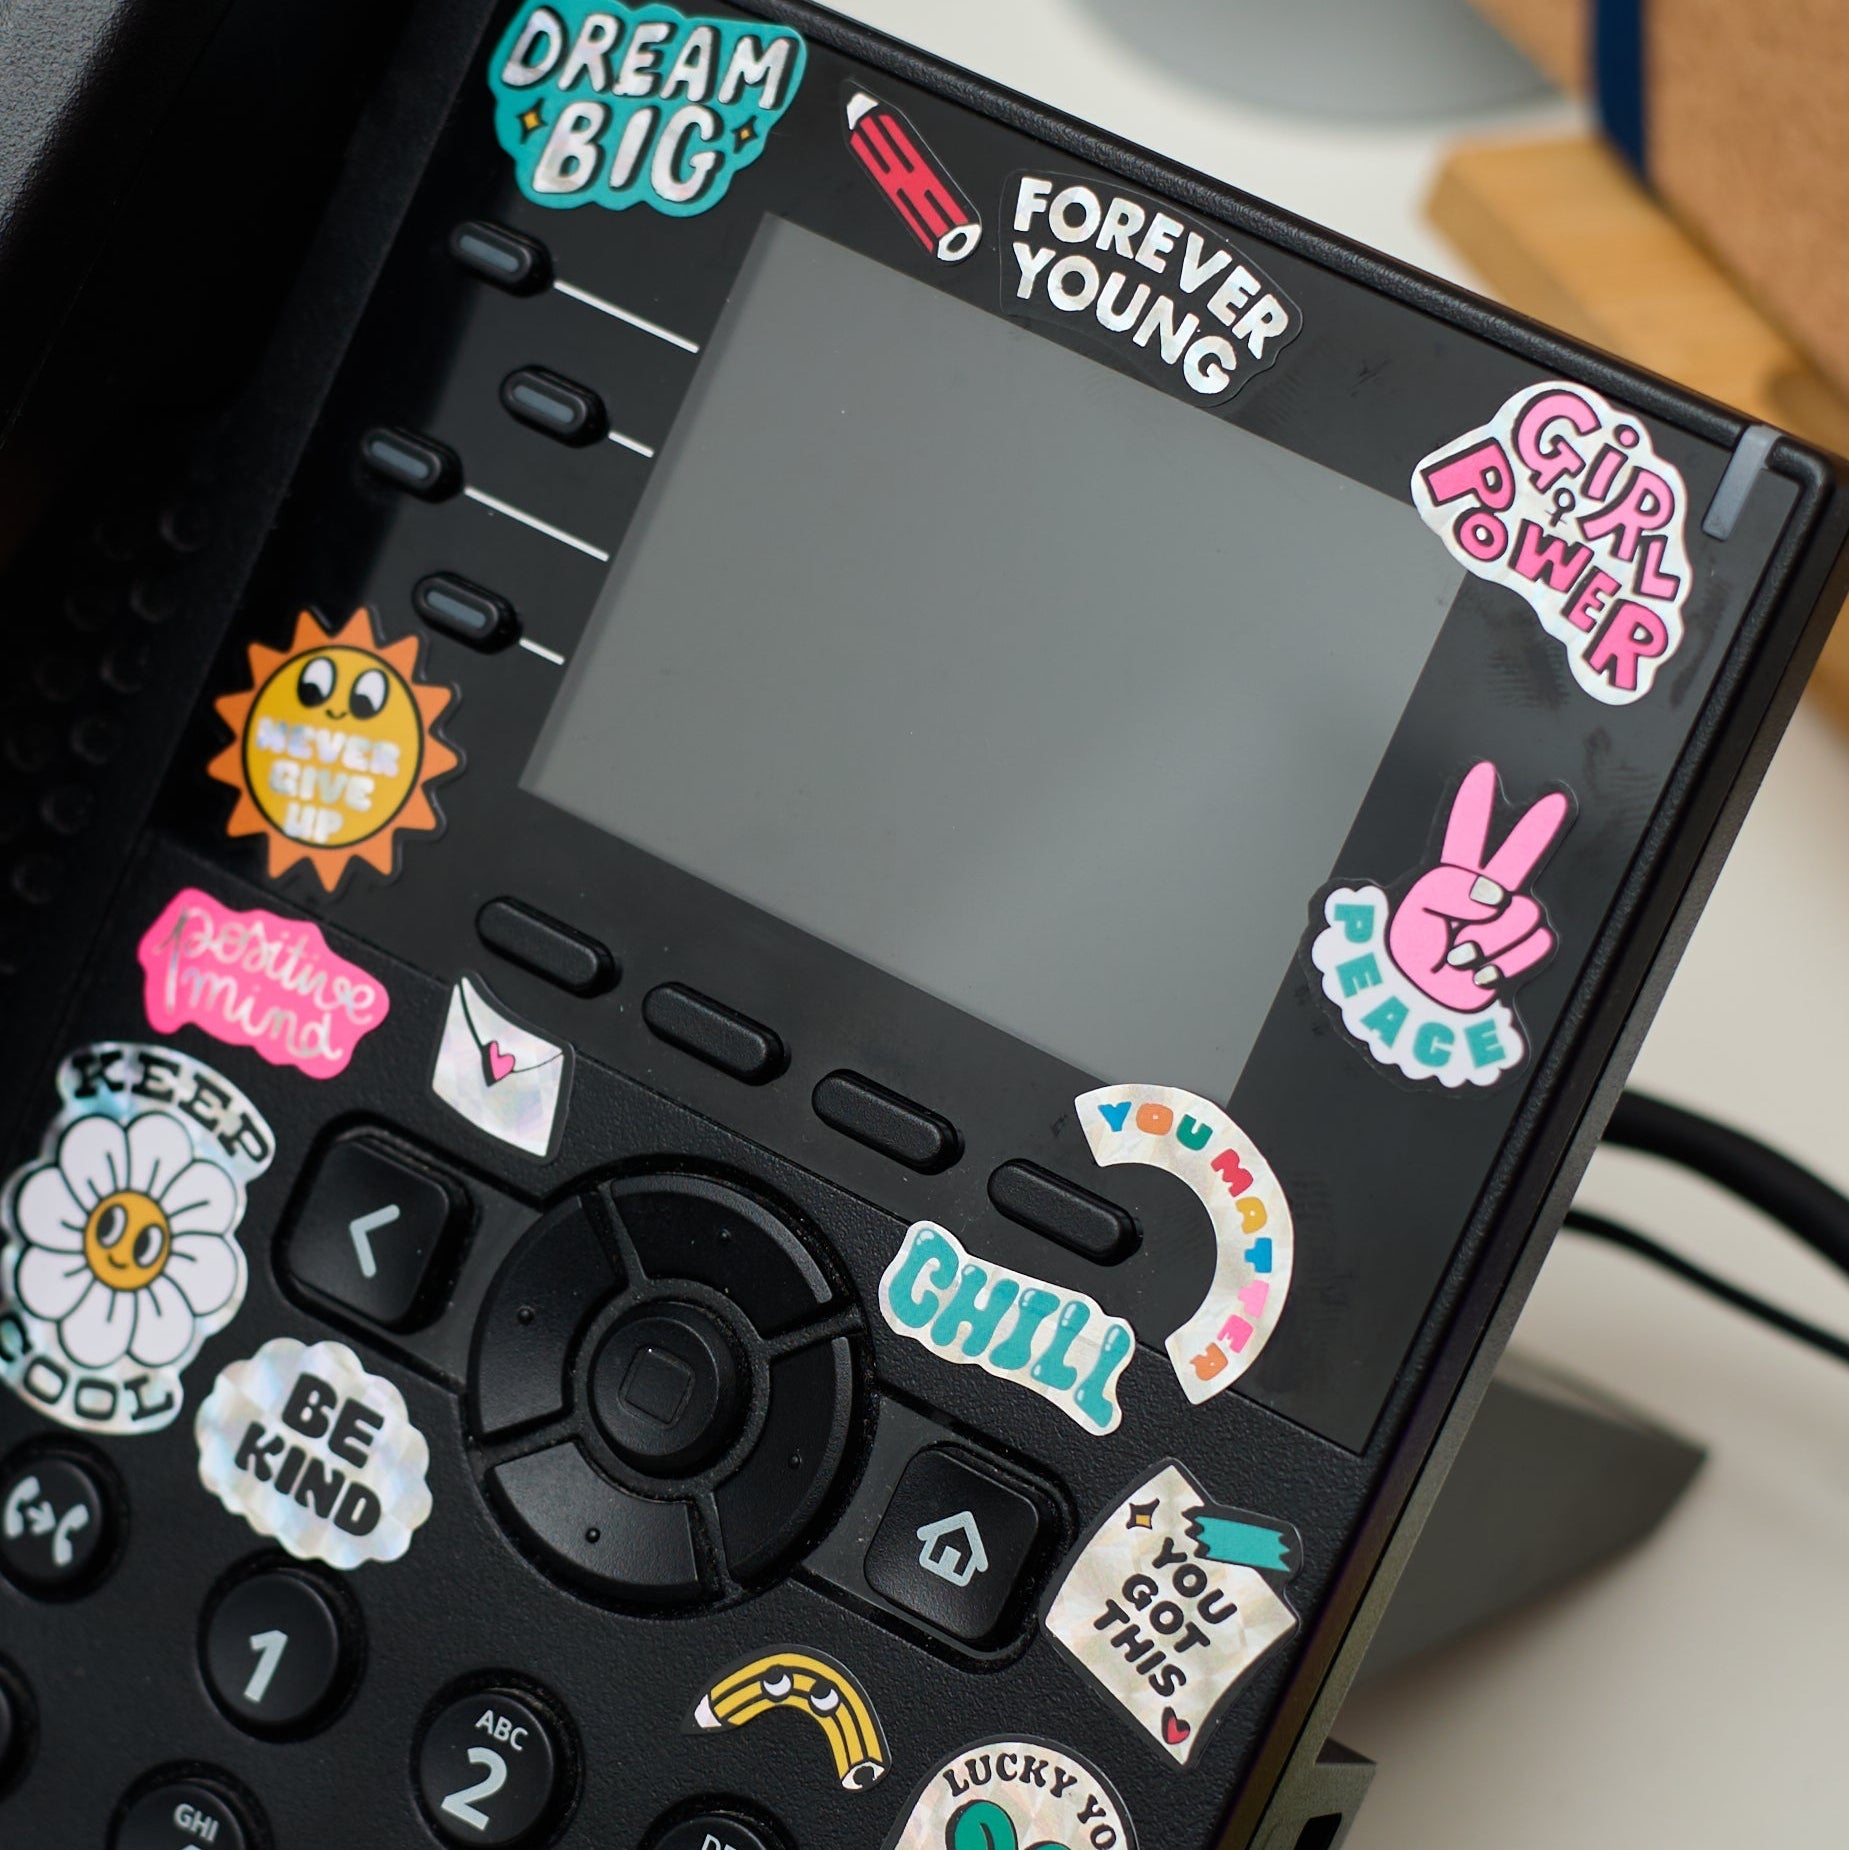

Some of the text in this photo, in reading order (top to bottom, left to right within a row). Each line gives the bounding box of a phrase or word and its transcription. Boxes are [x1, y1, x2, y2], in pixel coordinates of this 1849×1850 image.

[501, 7, 798, 110] DREAM
[532, 100, 724, 202] BIG
[1013, 177, 1289, 360] FOREVER
[1012, 242, 1237, 394] YOUNG
[1420, 437, 1669, 691] POWER
[256, 716, 401, 778] NEVER
[268, 759, 375, 812] GIVE
[283, 801, 344, 844] UP
[154, 906, 375, 1025] positive
[180, 967, 343, 1060] mind
[1334, 903, 1506, 1068] PEACE
[71, 1050, 270, 1163] KEEP
[1098, 1101, 1272, 1381] YOU MATTER
[0, 1311, 174, 1422] COOL
[888, 1228, 1131, 1428] CHILL
[281, 1372, 385, 1469] BE
[234, 1421, 382, 1537] KIND
[1122, 1573, 1211, 1653] GOT
[1152, 1537, 1238, 1625] YOU
[244, 1630, 289, 1703] 1
[1093, 1599, 1187, 1697] THIS
[475, 1709, 529, 1752] ABC
[943, 1752, 1078, 1798] LUCKY
[173, 1803, 219, 1842] GHI
[441, 1746, 508, 1831] 2
